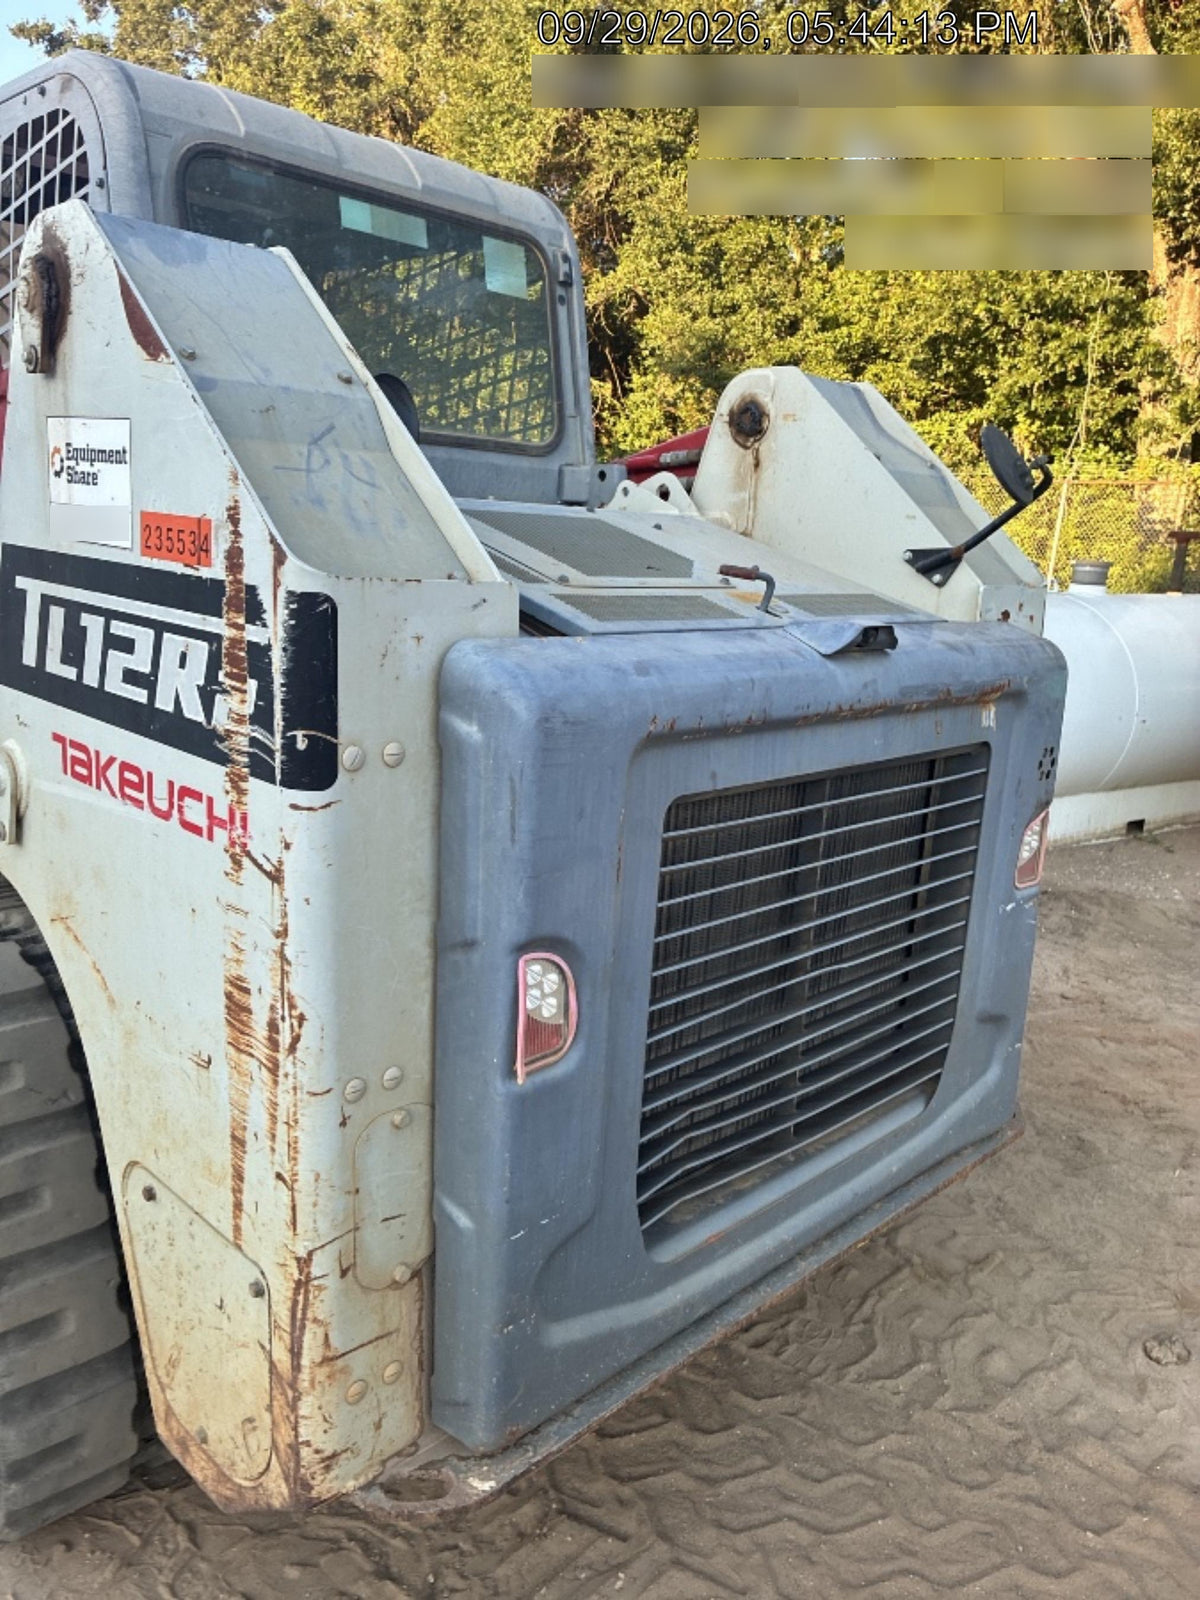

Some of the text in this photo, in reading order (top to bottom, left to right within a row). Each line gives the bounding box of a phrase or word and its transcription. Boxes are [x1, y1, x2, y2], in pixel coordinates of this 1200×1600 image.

[65, 442, 128, 466] Equipment
[66, 465, 99, 486] Share
[142, 523, 210, 559] 235534
